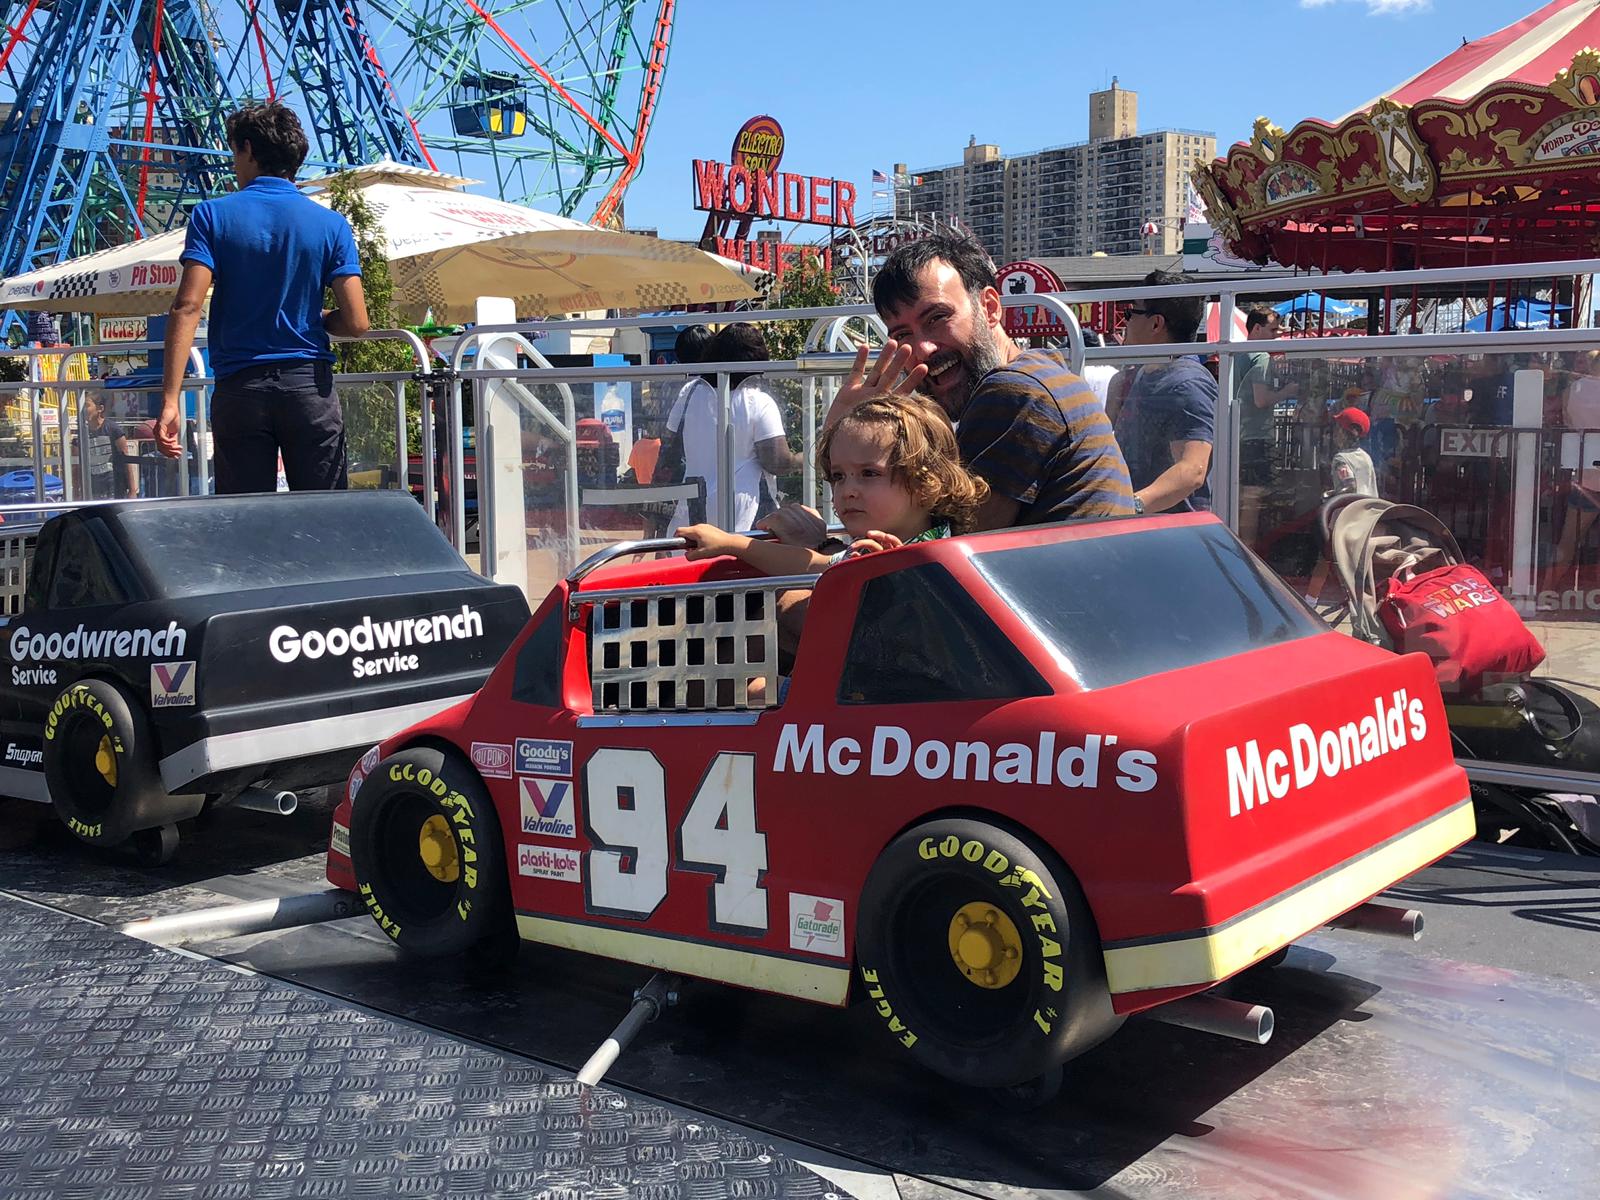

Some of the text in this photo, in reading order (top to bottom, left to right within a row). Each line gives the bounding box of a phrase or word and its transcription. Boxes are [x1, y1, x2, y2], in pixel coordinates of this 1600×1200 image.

[738, 131, 783, 156] ELECTRO
[1541, 134, 1576, 154] WONDER
[692, 159, 857, 228] WONDER
[131, 265, 147, 286] Pit
[150, 264, 177, 285] Stop
[8, 283, 32, 297] pepsi
[1014, 303, 1092, 327] STATON
[102, 320, 147, 339] TICKETS
[1426, 578, 1487, 603] STAR
[1423, 589, 1498, 618] WARS
[10, 621, 187, 661] Goodwrench
[269, 604, 484, 663] Goodwrench
[12, 665, 57, 686] Service
[352, 652, 419, 678] Service
[154, 692, 193, 706] Valvoline
[45, 691, 113, 740] GOODYEAR
[519, 743, 569, 761] Goody's
[772, 723, 1158, 792] McDonald's
[1226, 688, 1427, 818] McDonald's
[67, 817, 102, 837] EAGLE
[523, 815, 573, 835] Valvoline
[584, 747, 768, 931] 94
[520, 849, 577, 871] plasti-kote
[533, 868, 565, 878] SPRAY PAINT
[358, 882, 402, 939] EAGLE
[918, 835, 1064, 992] GOODYEAR
[797, 917, 839, 934] Gatorade
[861, 966, 918, 1049] EAGLE
